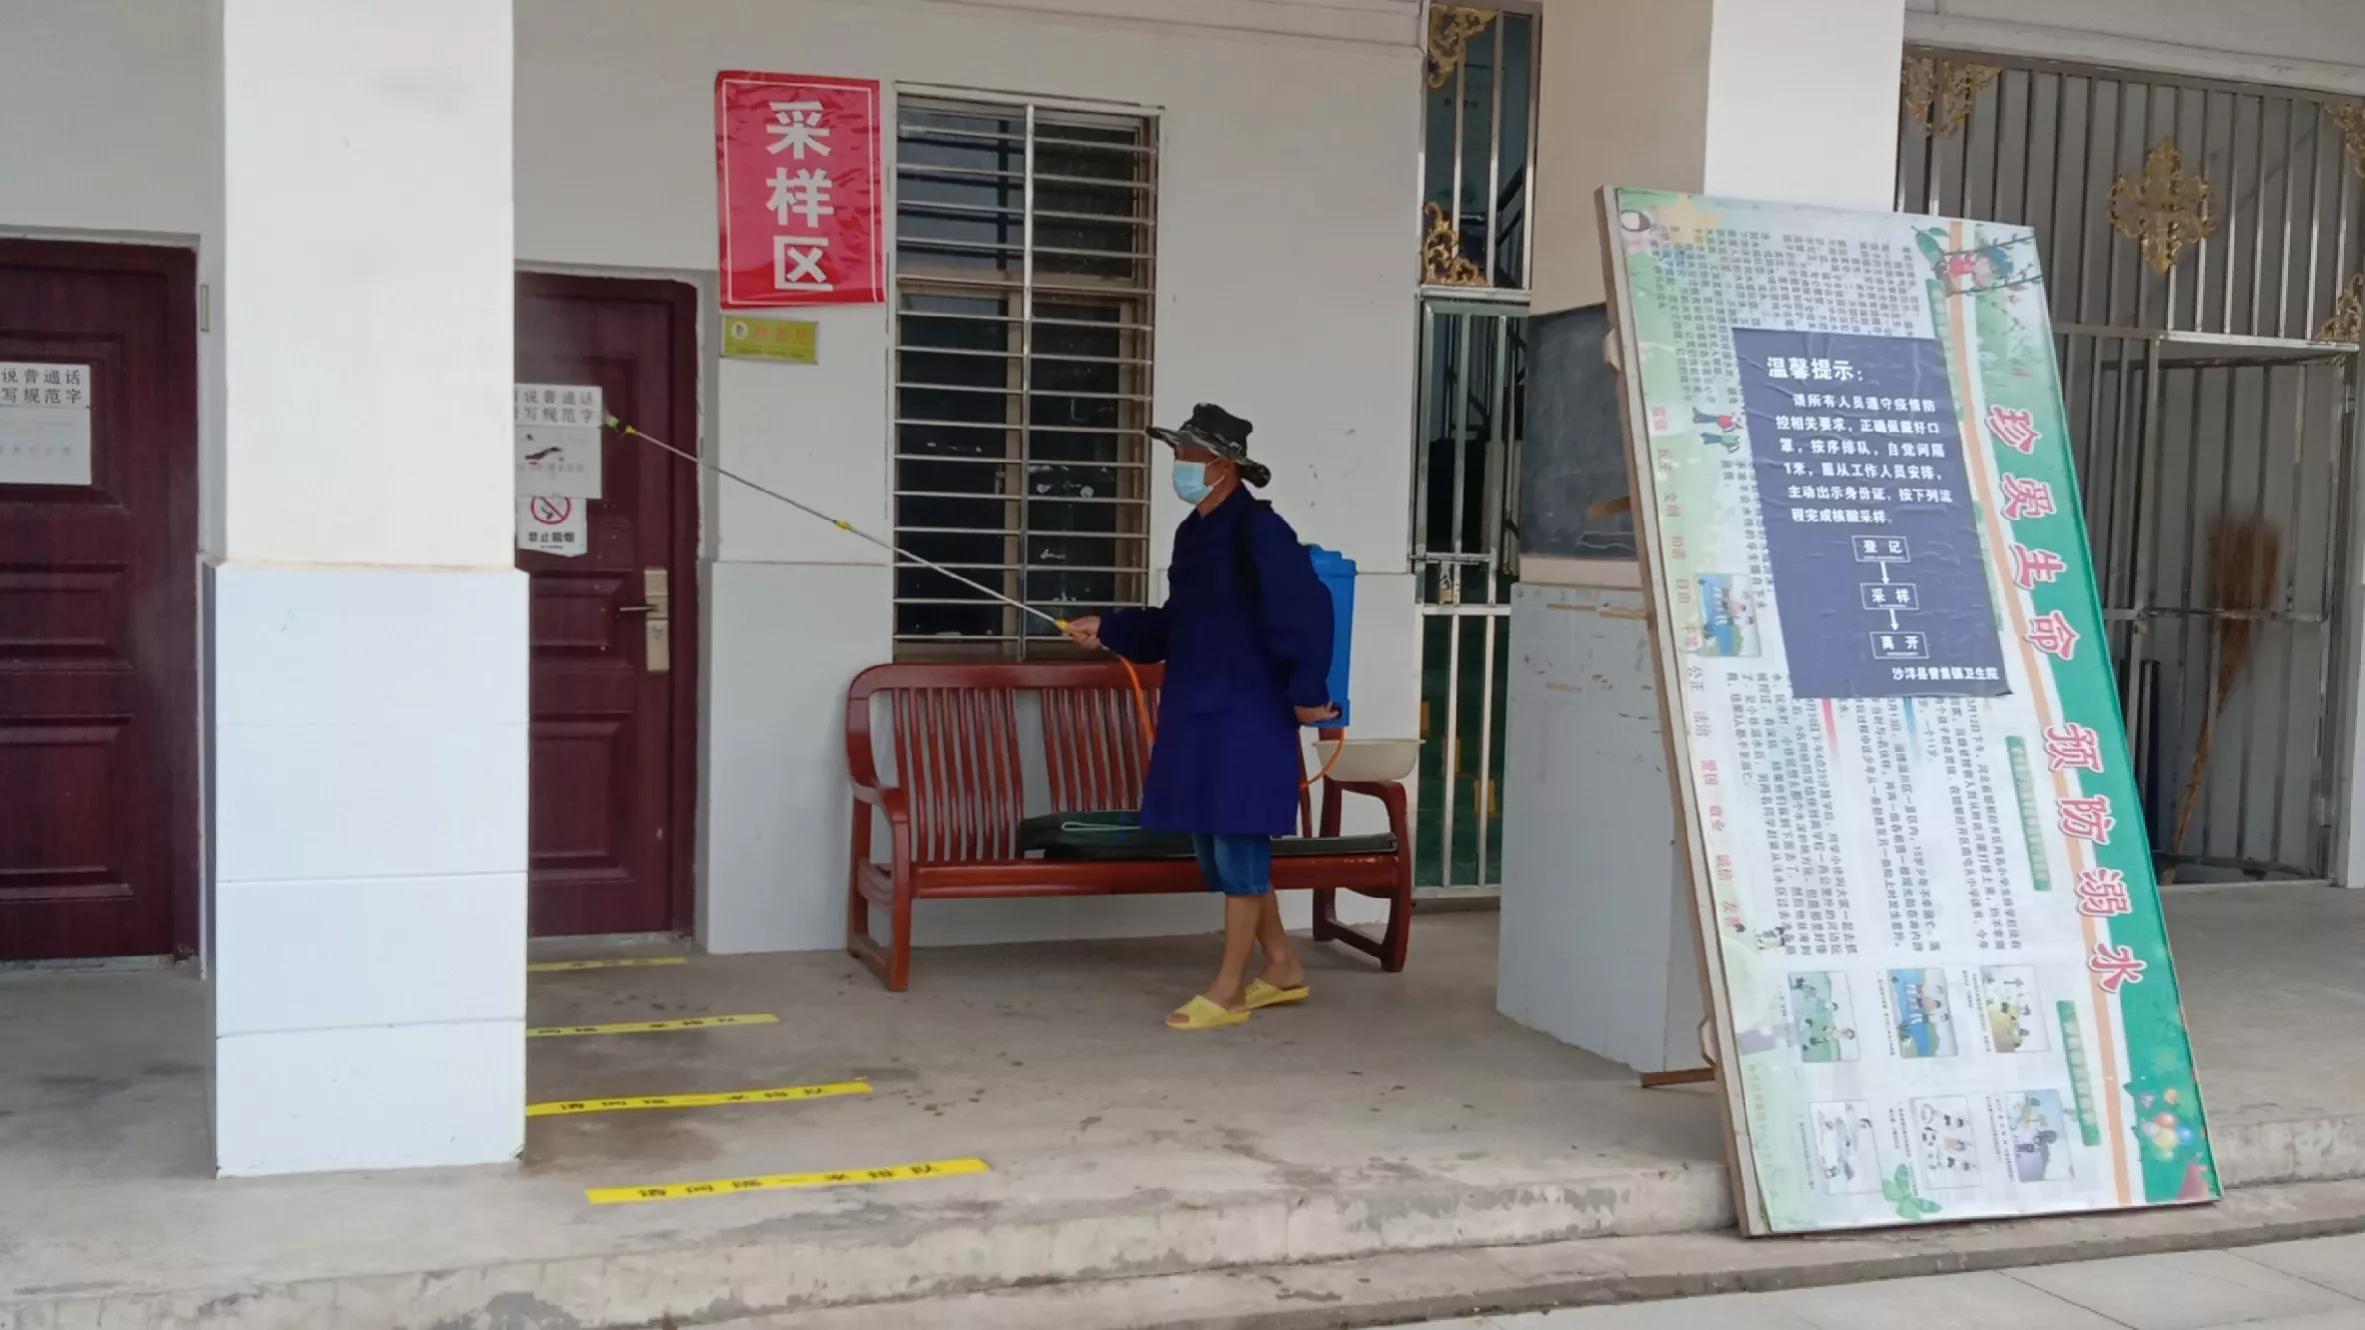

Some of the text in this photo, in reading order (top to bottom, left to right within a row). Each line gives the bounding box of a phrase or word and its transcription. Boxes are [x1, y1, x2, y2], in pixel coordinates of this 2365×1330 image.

[766, 101, 834, 292] 采样区
[1767, 357, 1863, 382] 温馨提示：
[1792, 393, 1936, 412] 请所有人员遵守疫情防
[1872, 588, 1910, 603] 采样
[1685, 665, 1705, 692] 公正
[1985, 404, 2147, 993] 珍爱生命 预防溺水
